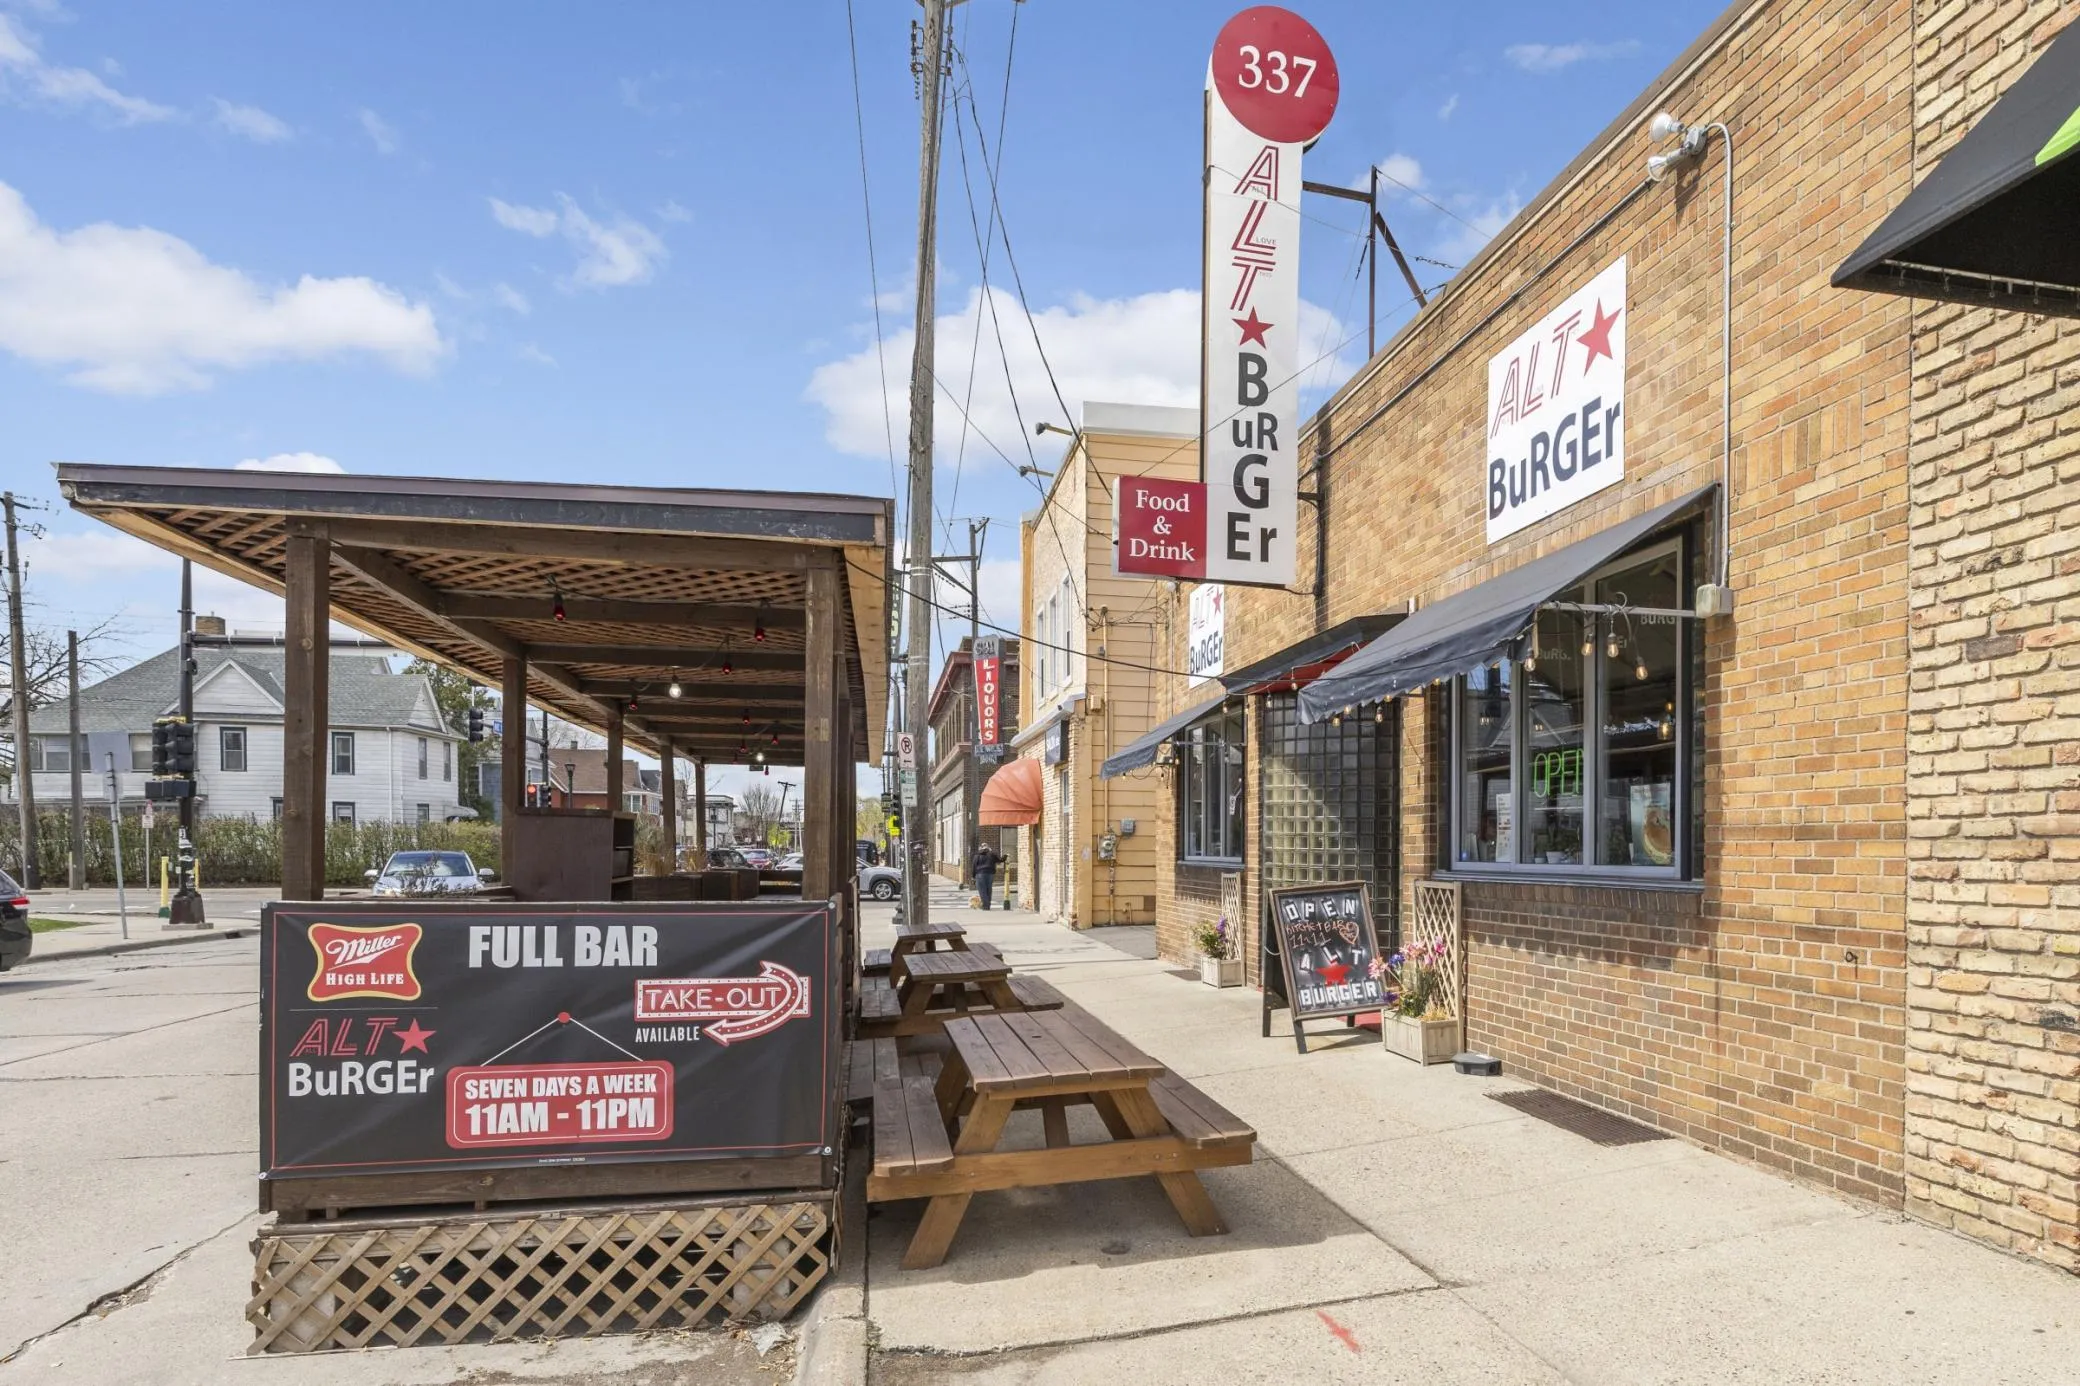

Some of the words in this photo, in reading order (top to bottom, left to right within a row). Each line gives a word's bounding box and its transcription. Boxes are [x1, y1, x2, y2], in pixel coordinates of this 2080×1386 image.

[1238, 45, 1317, 98] 337
[1231, 145, 1279, 311] ALT
[1489, 309, 1582, 440] ALT
[1489, 396, 1621, 521] BuRGEr
[1135, 490, 1190, 513] Food
[1153, 515, 1173, 535] &
[1129, 538, 1195, 562] Drink
[1190, 631, 1223, 675] BuRGEr
[1285, 900, 1356, 919] OPEN
[326, 932, 405, 962] Miller
[469, 925, 564, 968] FULL
[574, 925, 659, 967] BAR
[1301, 946, 1364, 969] ALT
[325, 972, 364, 986] HIGH
[370, 972, 404, 986] LIFE
[645, 986, 784, 1011] TAKE-OUT
[1300, 981, 1378, 1006] BURGER
[289, 1017, 399, 1057] ALT
[635, 1026, 701, 1044] AVAILABLE
[288, 1060, 435, 1097] BuRGEr
[465, 1075, 528, 1100] SEVEN
[532, 1074, 582, 1098] DAYS
[585, 1074, 601, 1095] A
[602, 1073, 657, 1094] WEEK
[465, 1102, 549, 1136] 11AM
[575, 1097, 655, 1131] 11PM
